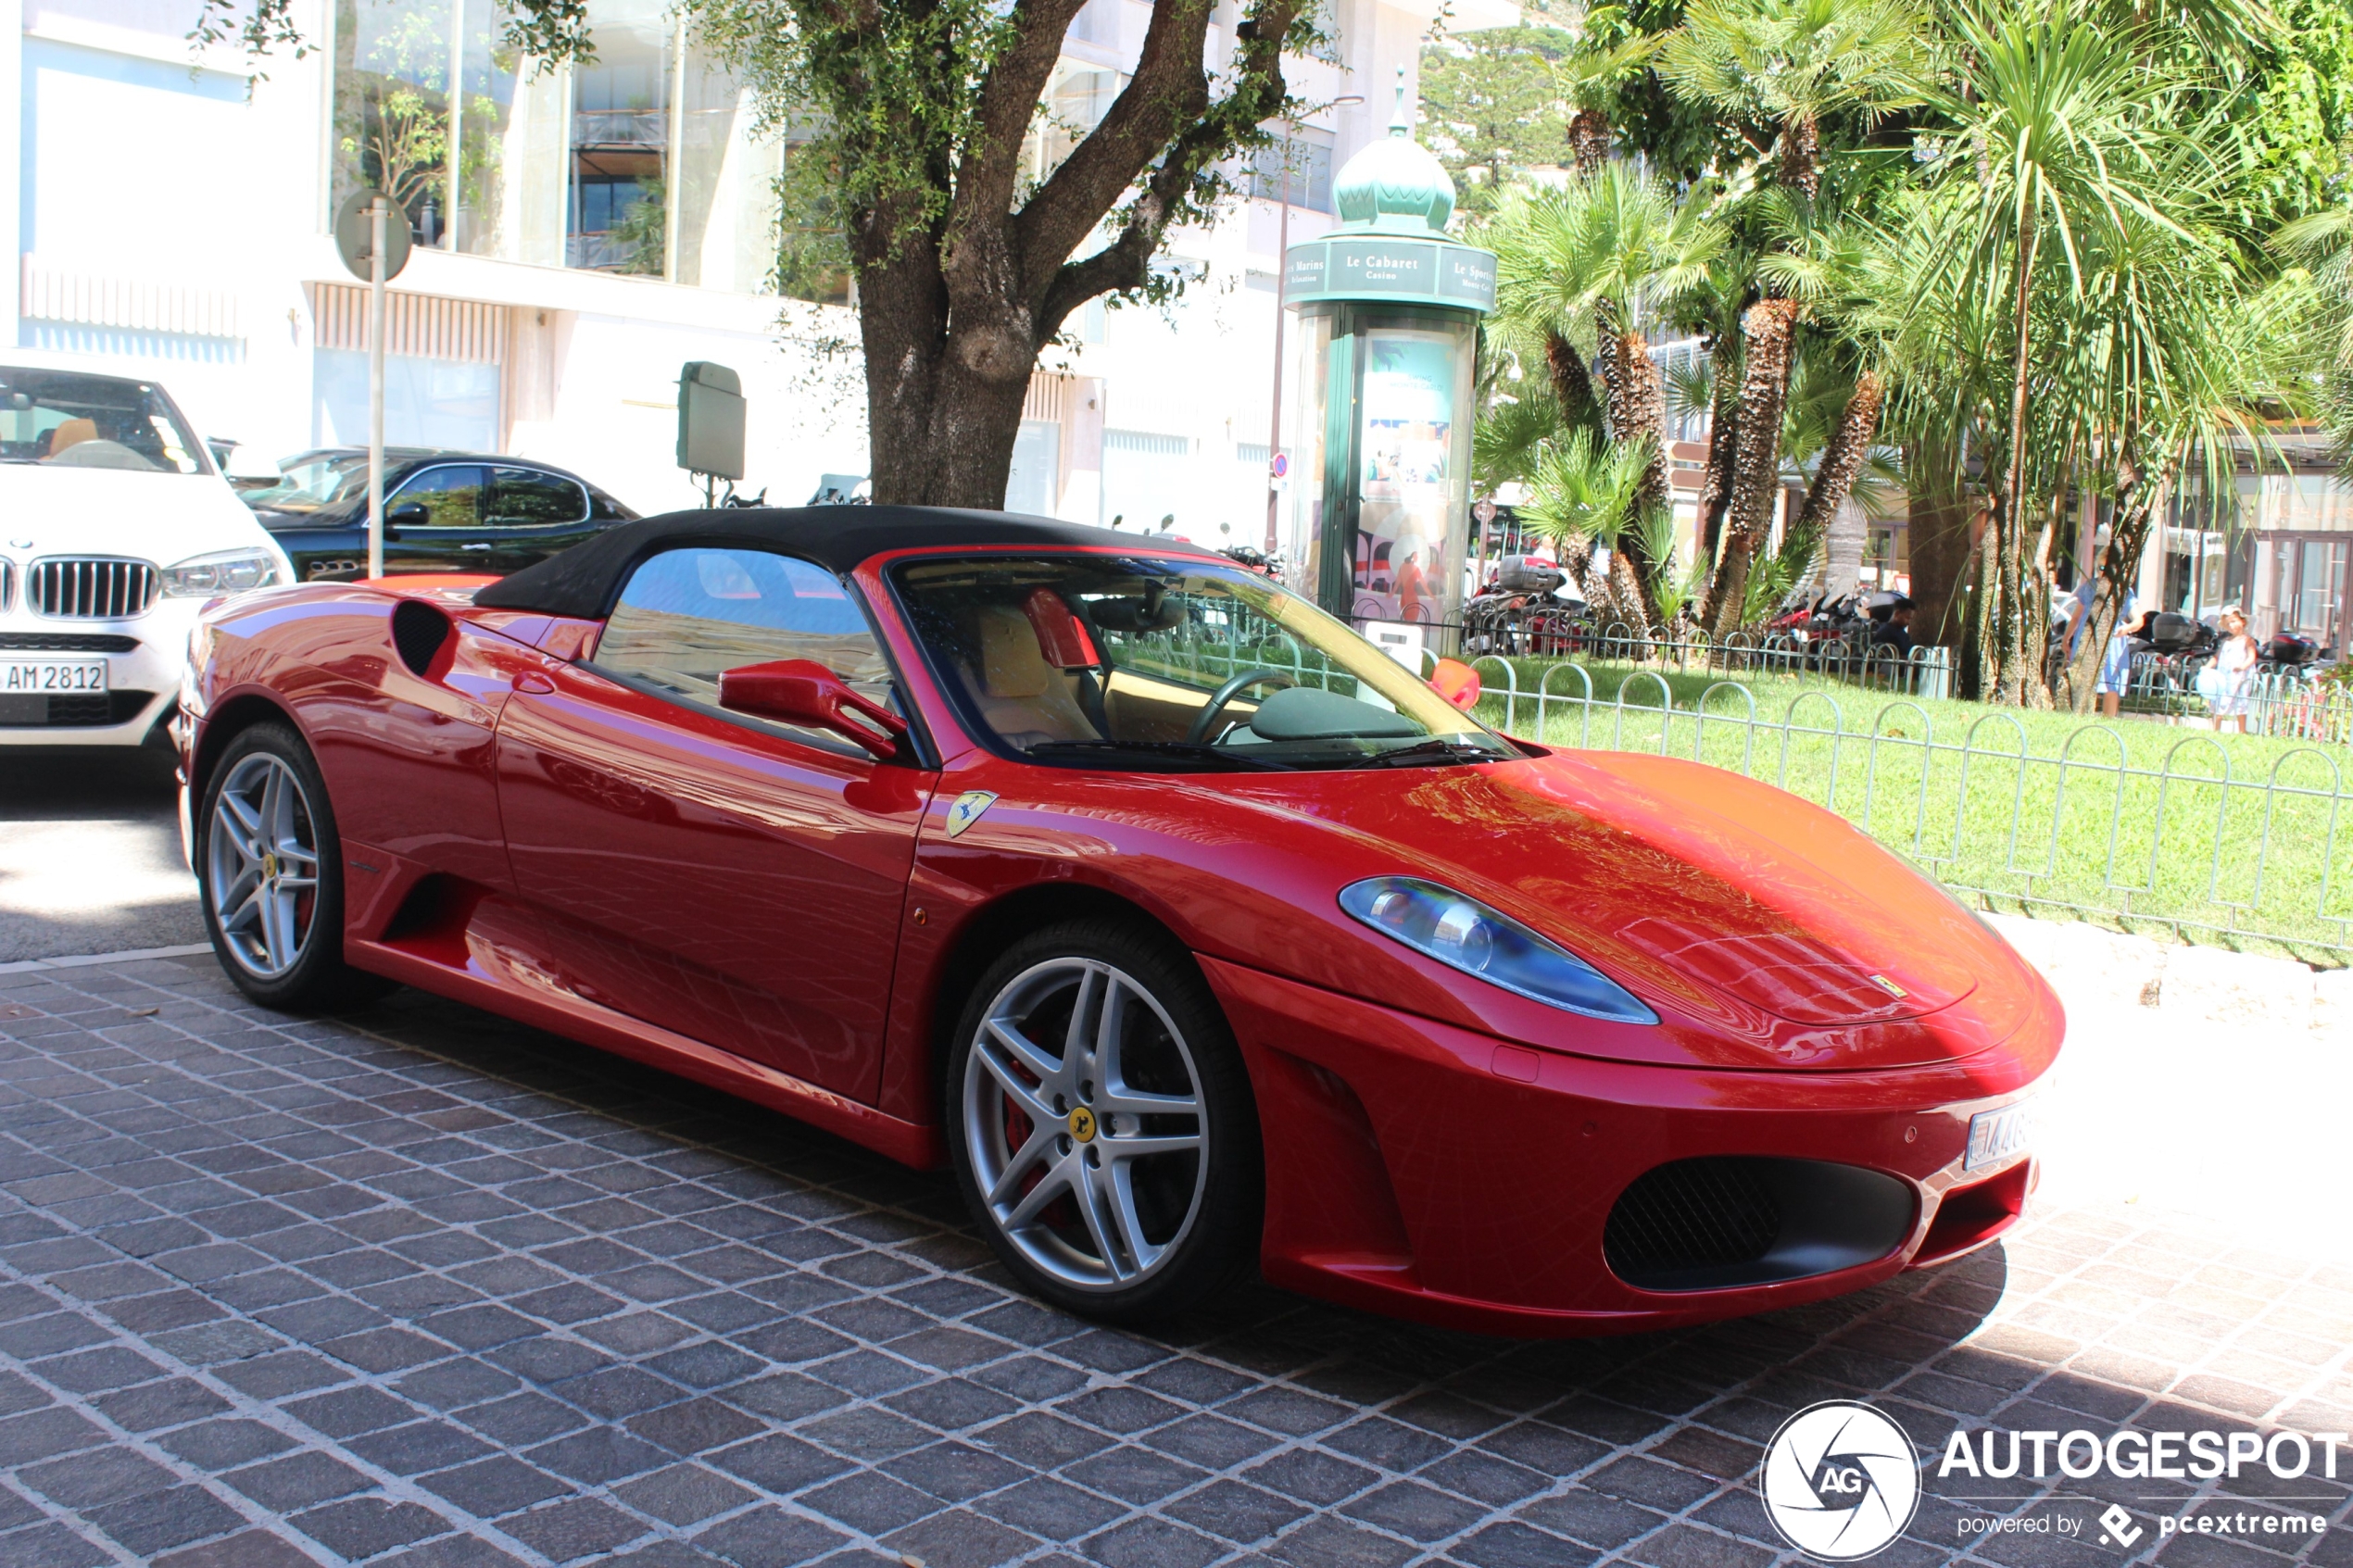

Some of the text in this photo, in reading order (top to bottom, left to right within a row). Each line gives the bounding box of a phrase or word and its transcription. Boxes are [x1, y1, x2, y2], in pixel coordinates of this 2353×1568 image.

[1296, 259, 1324, 271] Marins
[1346, 255, 1418, 270] Le Cabaret
[1454, 262, 1466, 275] Le
[1365, 270, 1397, 280] Casino
[1407, 373, 1433, 383] SWING
[6, 666, 102, 689] AM 2812
